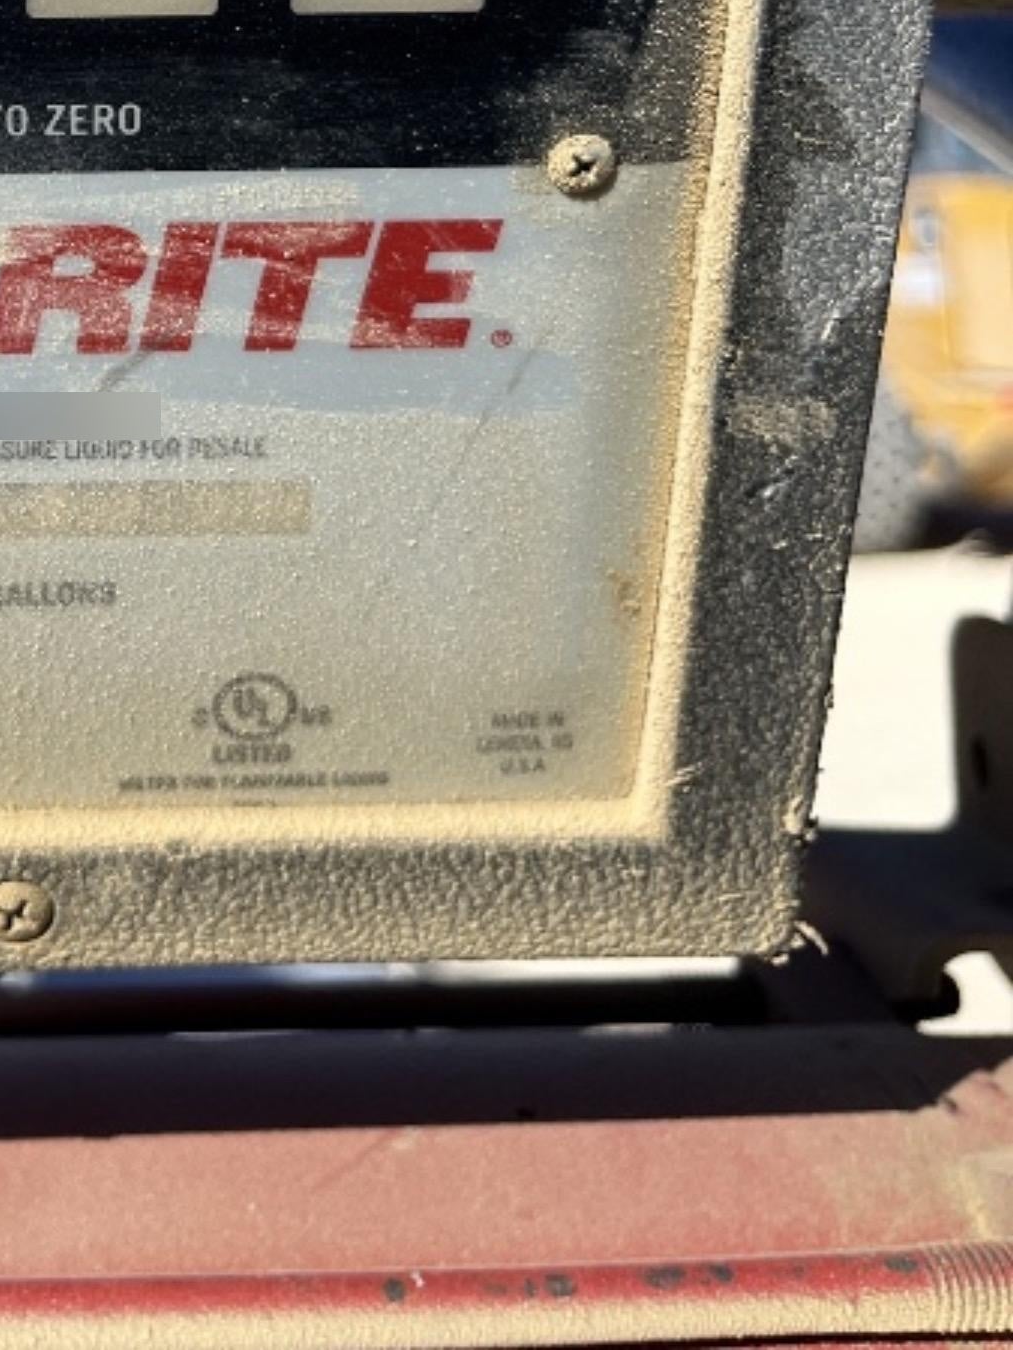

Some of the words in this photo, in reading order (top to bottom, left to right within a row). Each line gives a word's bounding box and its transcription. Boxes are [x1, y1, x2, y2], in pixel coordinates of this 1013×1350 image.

[44, 103, 142, 137] ZERO
[139, 436, 182, 461] FOR
[211, 743, 293, 765] LISTED
